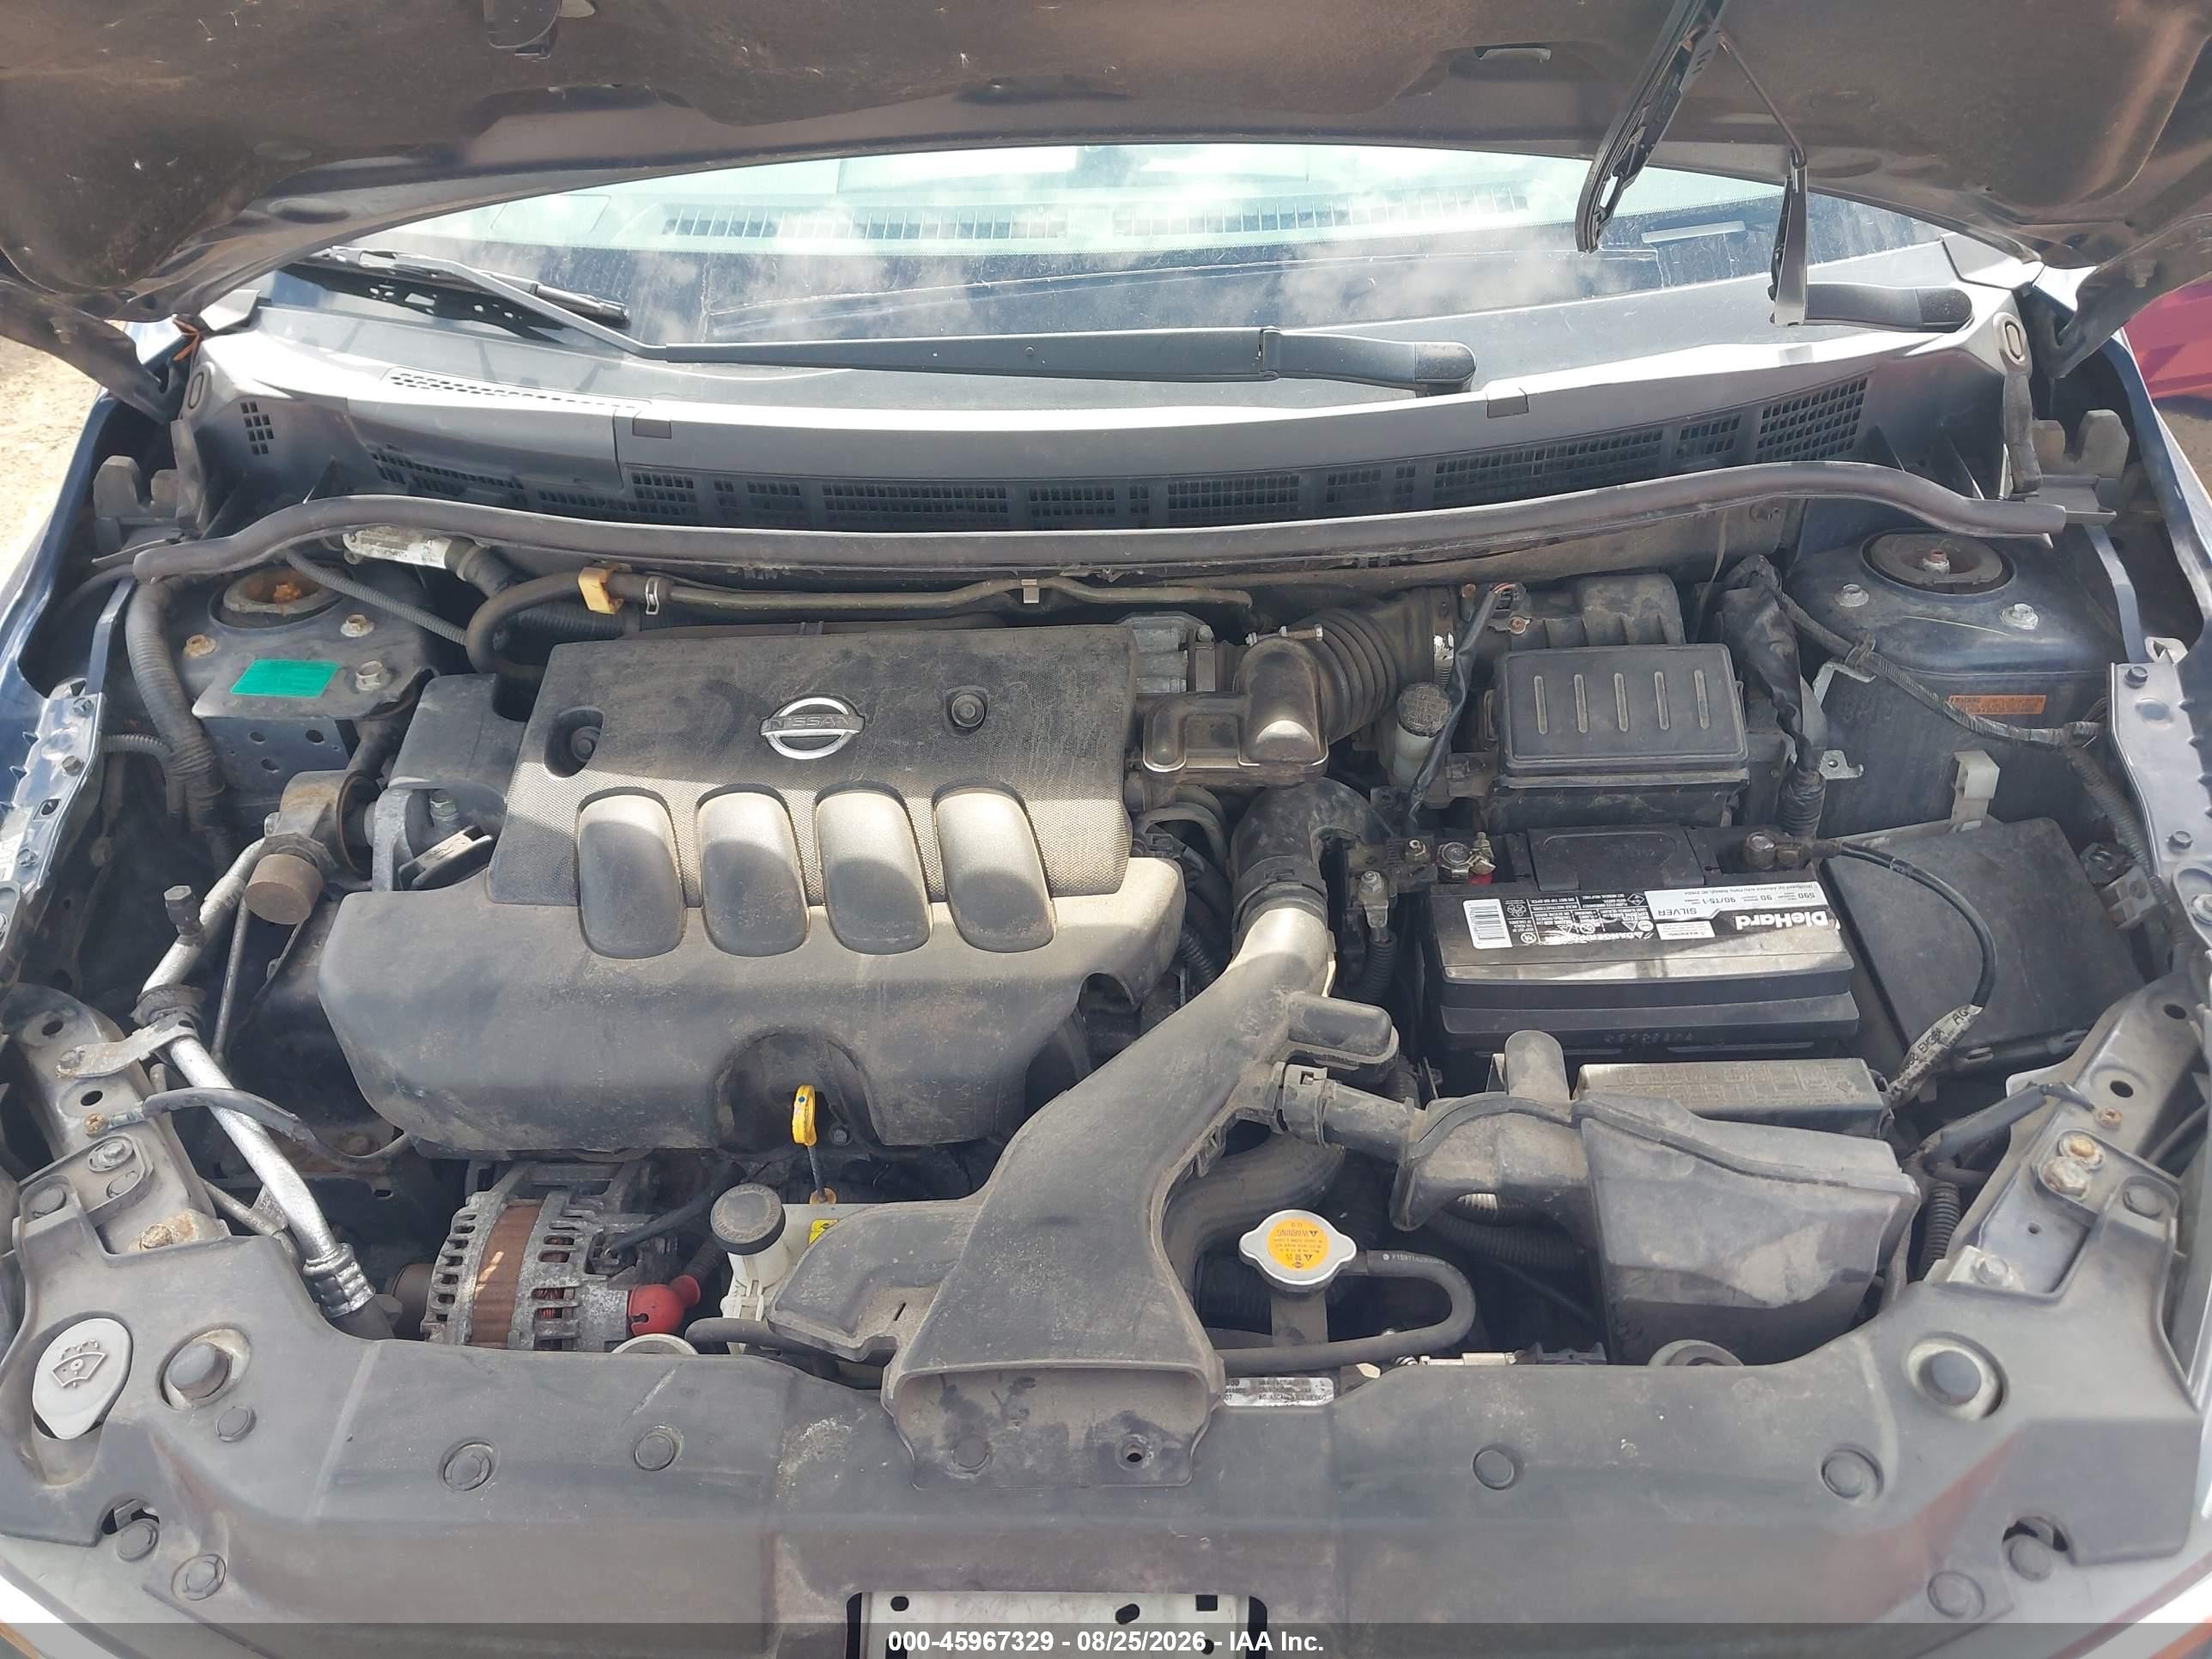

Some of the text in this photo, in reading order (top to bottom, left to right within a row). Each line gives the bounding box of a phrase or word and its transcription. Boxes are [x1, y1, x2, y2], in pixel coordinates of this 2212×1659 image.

[769, 715, 854, 729] NISSAN
[1657, 908, 1698, 916] SILVER
[1735, 910, 1829, 931] DieHard
